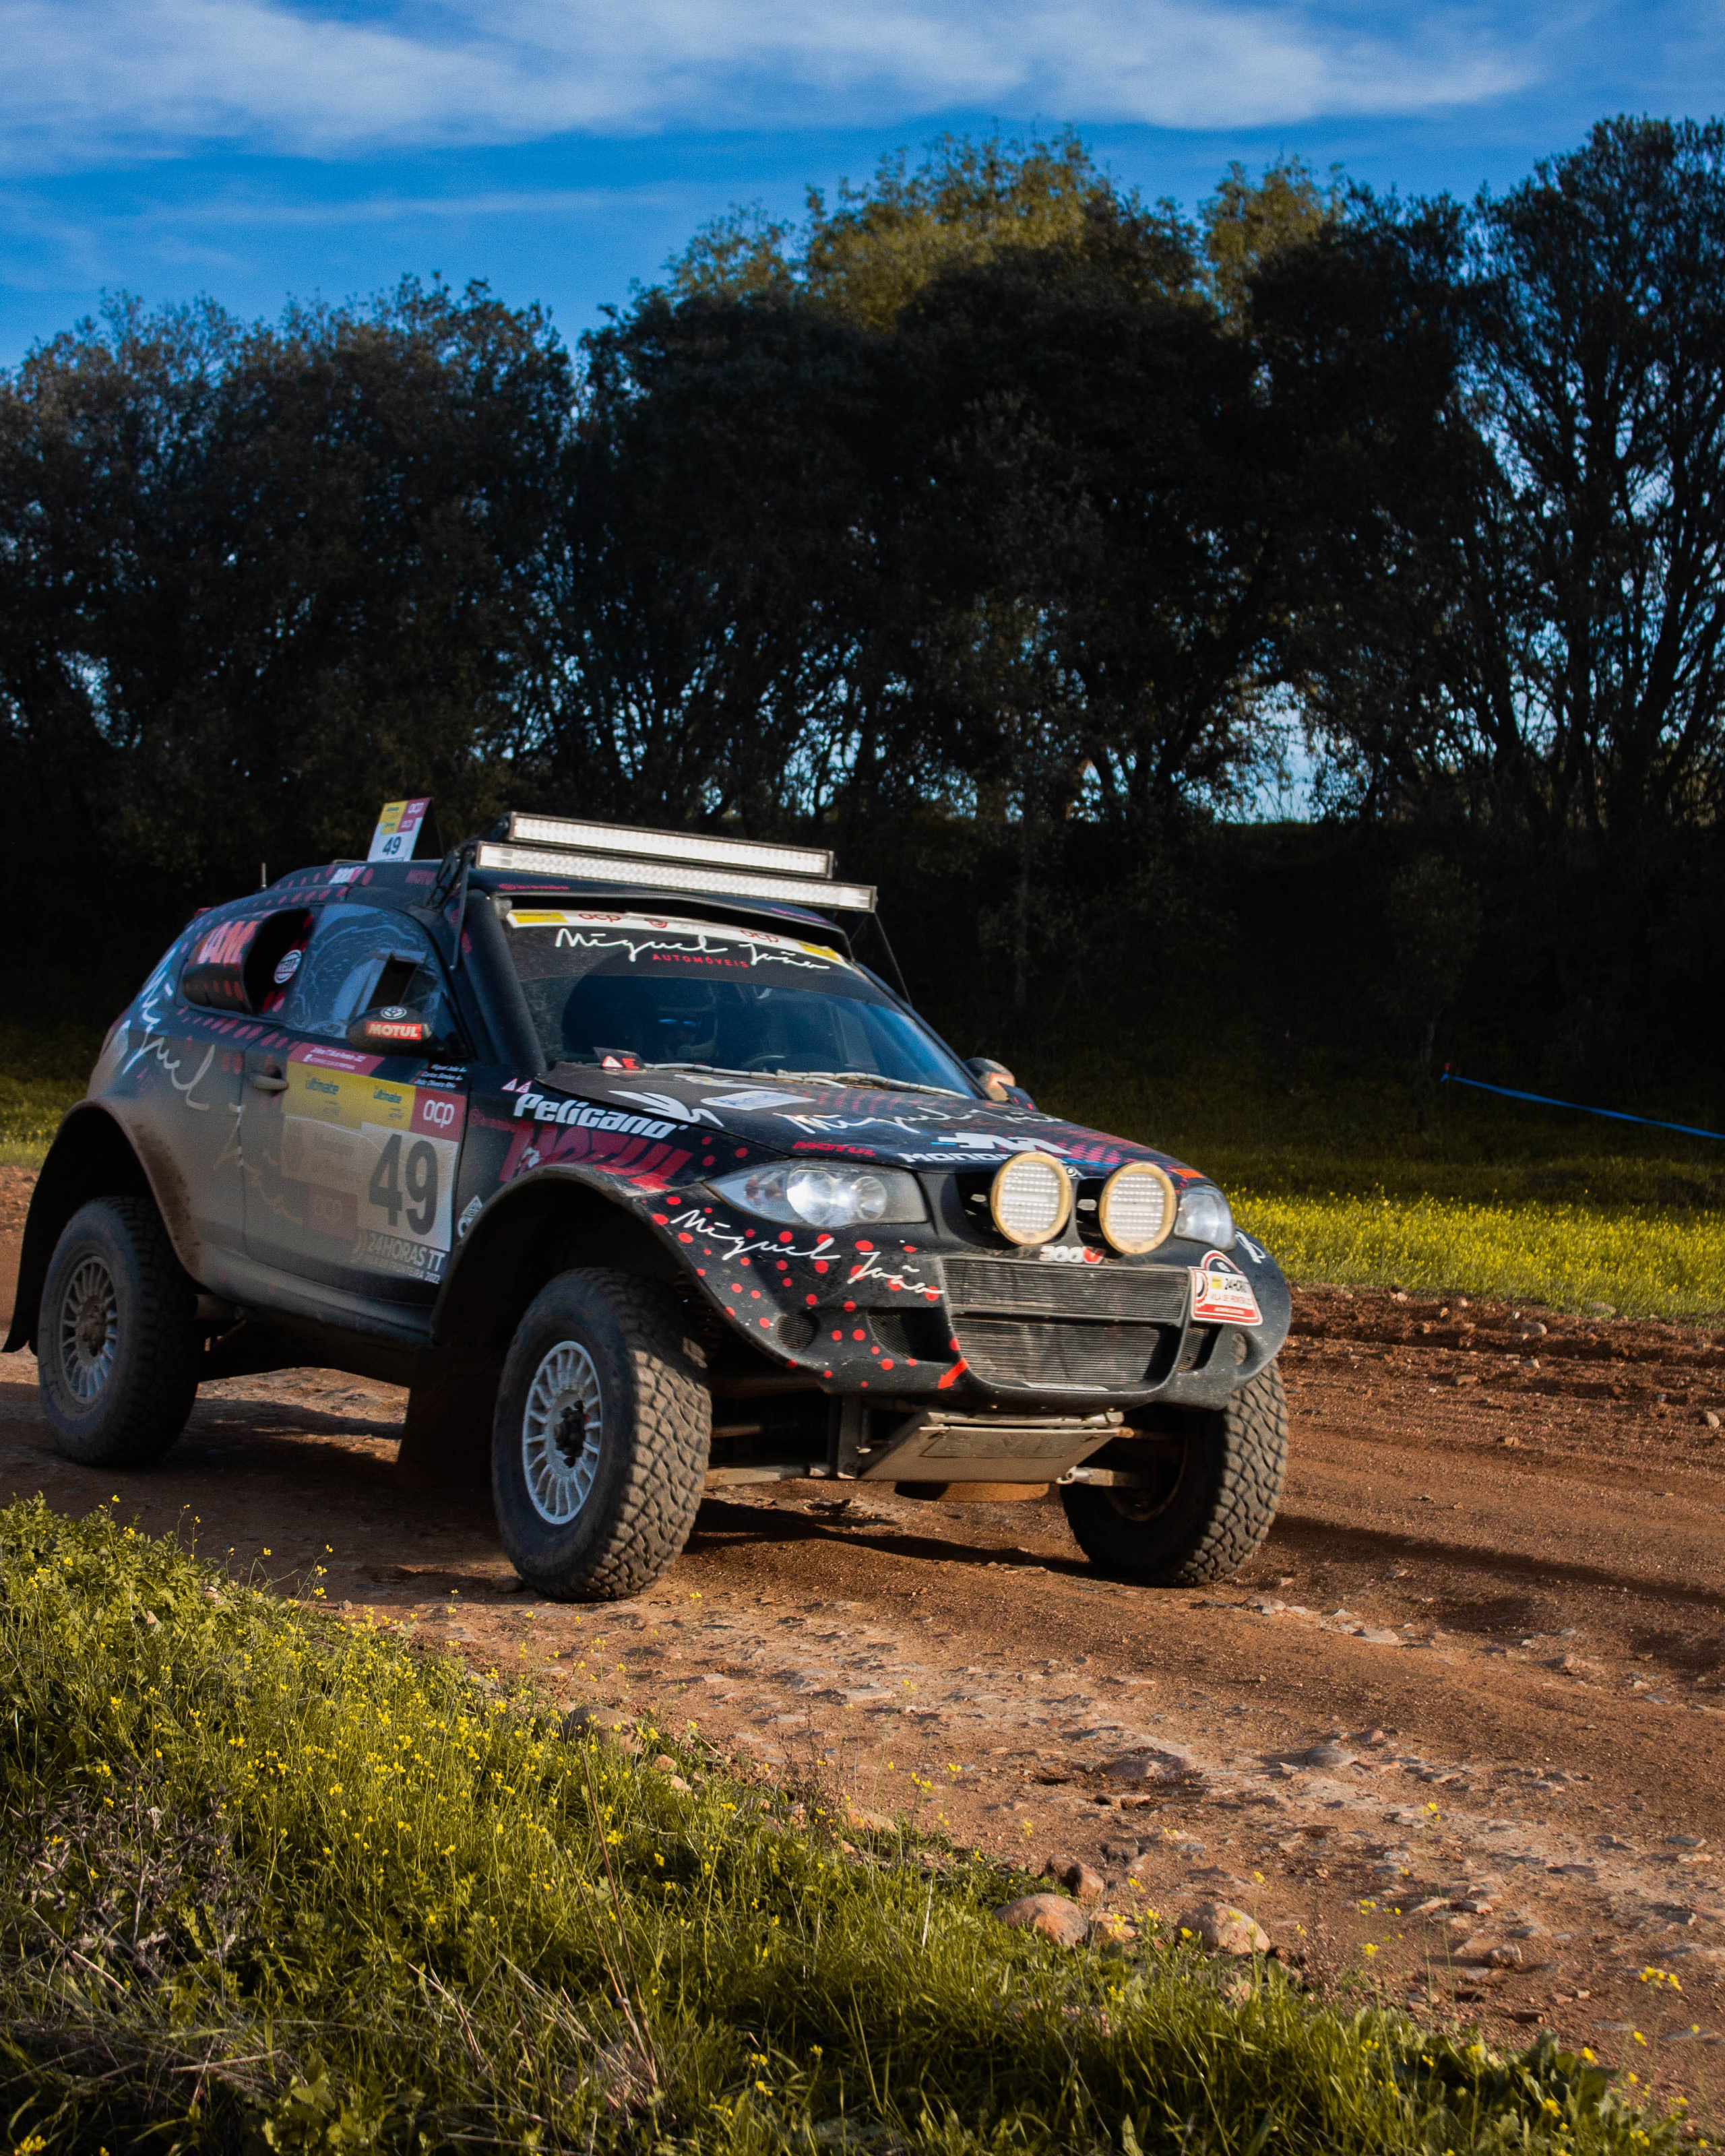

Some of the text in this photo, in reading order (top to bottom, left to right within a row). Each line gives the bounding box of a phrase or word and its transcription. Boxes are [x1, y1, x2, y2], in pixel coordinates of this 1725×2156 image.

[382, 836, 402, 856] 49
[555, 928, 728, 962] Miguel
[739, 943, 830, 970] João
[652, 953, 749, 968] AUTOMÓVEIS
[368, 1023, 418, 1038] MOTUL
[423, 1100, 455, 1129] acp
[513, 1093, 677, 1139] Pelicano
[792, 1141, 876, 1156] MOTUL
[370, 1133, 438, 1235] 49
[670, 1209, 945, 1294] Miguel João
[1038, 1245, 1106, 1265] 300V
